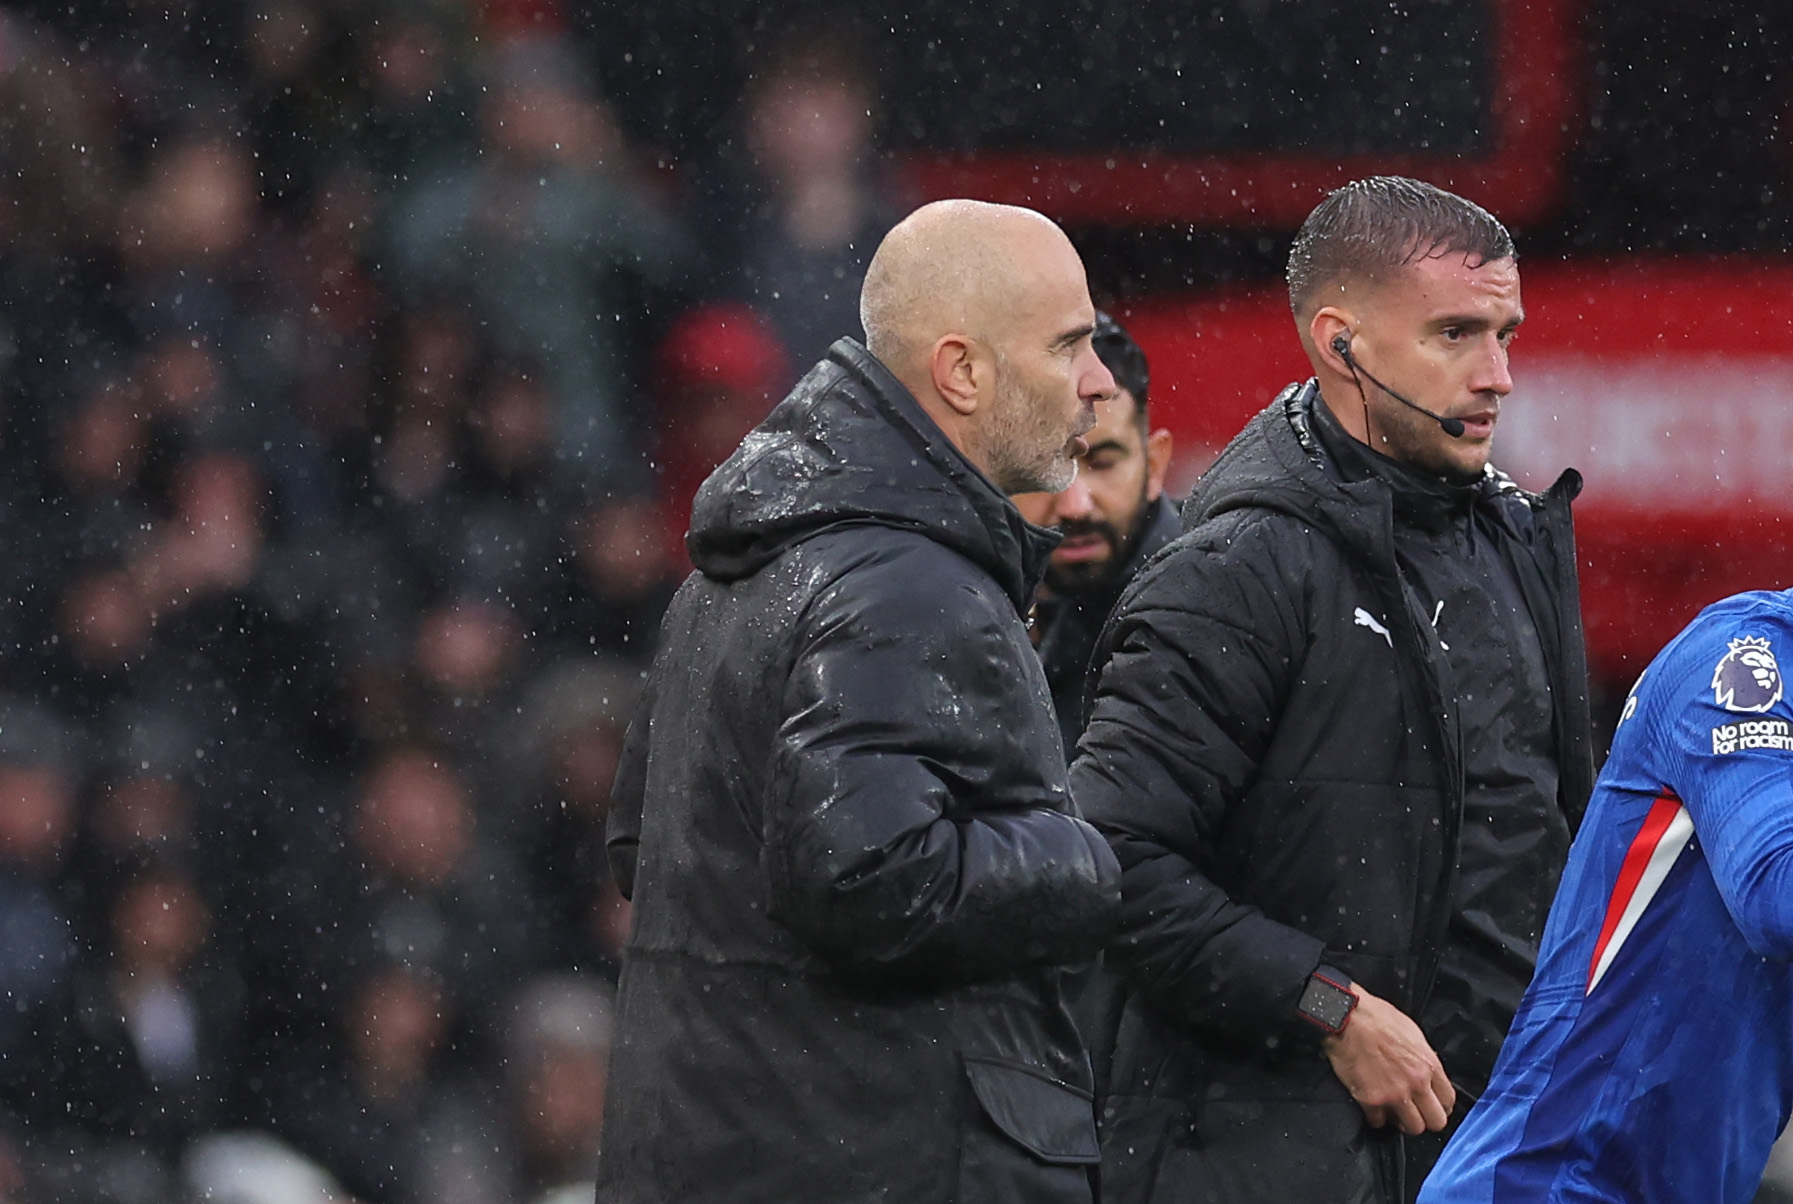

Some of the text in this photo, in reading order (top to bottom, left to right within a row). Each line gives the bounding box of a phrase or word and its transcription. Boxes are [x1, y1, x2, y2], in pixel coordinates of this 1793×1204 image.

[1712, 721, 1788, 744] No room
[1713, 738, 1738, 755] for
